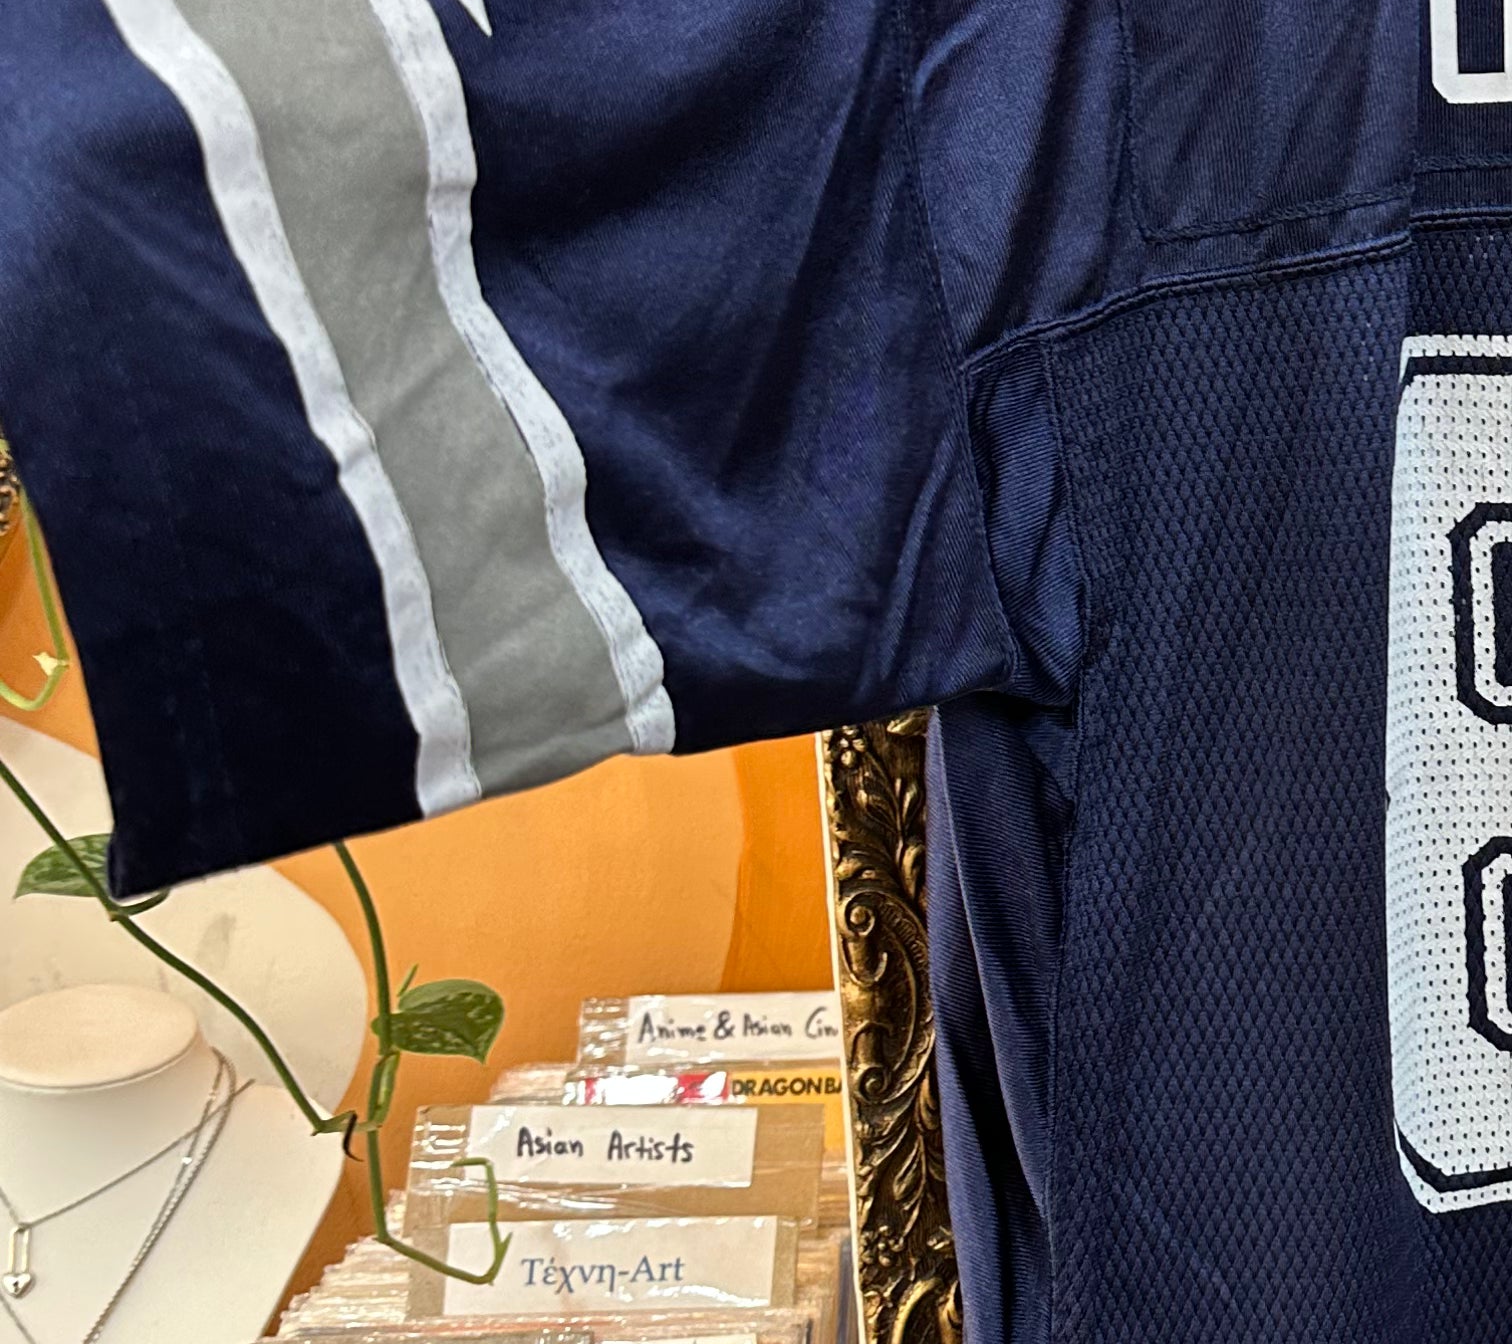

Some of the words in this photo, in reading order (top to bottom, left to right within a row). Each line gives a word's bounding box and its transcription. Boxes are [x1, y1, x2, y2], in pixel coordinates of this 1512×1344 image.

[637, 1012, 706, 1043] Anime
[713, 1010, 735, 1040] &
[743, 1013, 792, 1036] Asian
[517, 1127, 583, 1157] Asian
[607, 1129, 694, 1163] Artists
[520, 1256, 685, 1295] Τέχνη-Art
